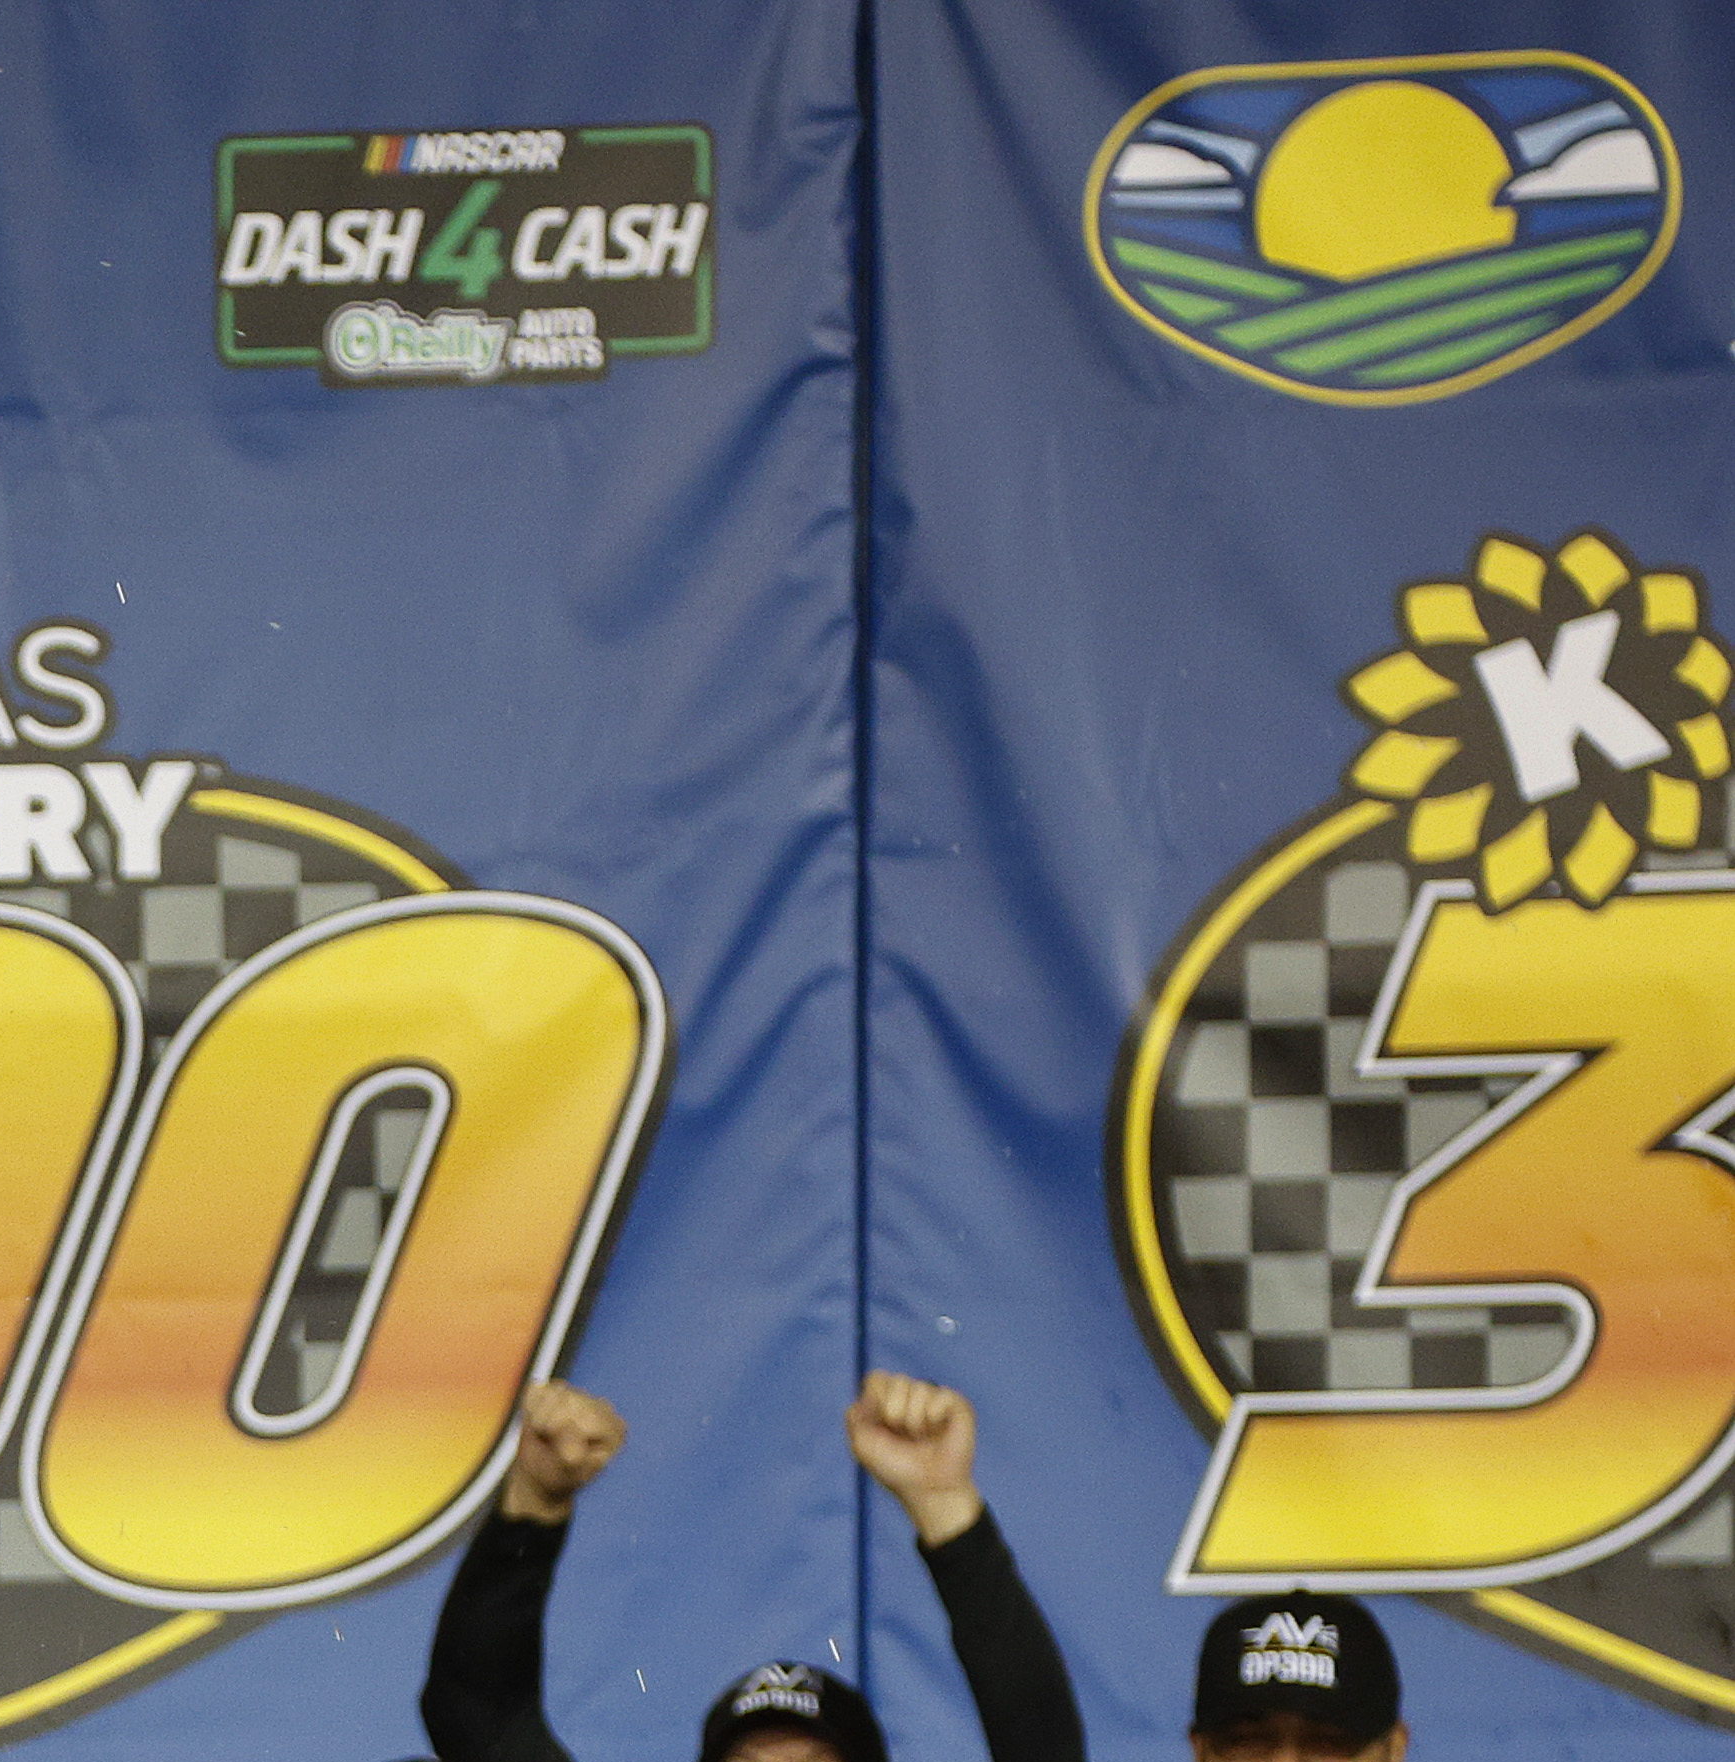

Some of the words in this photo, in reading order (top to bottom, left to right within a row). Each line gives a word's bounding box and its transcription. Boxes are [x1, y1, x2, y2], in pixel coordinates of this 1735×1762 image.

[413, 131, 566, 174] NASCAR
[220, 206, 425, 286] DASH
[419, 180, 505, 299] 4
[512, 203, 710, 282] CASH
[1472, 610, 1671, 802] K
